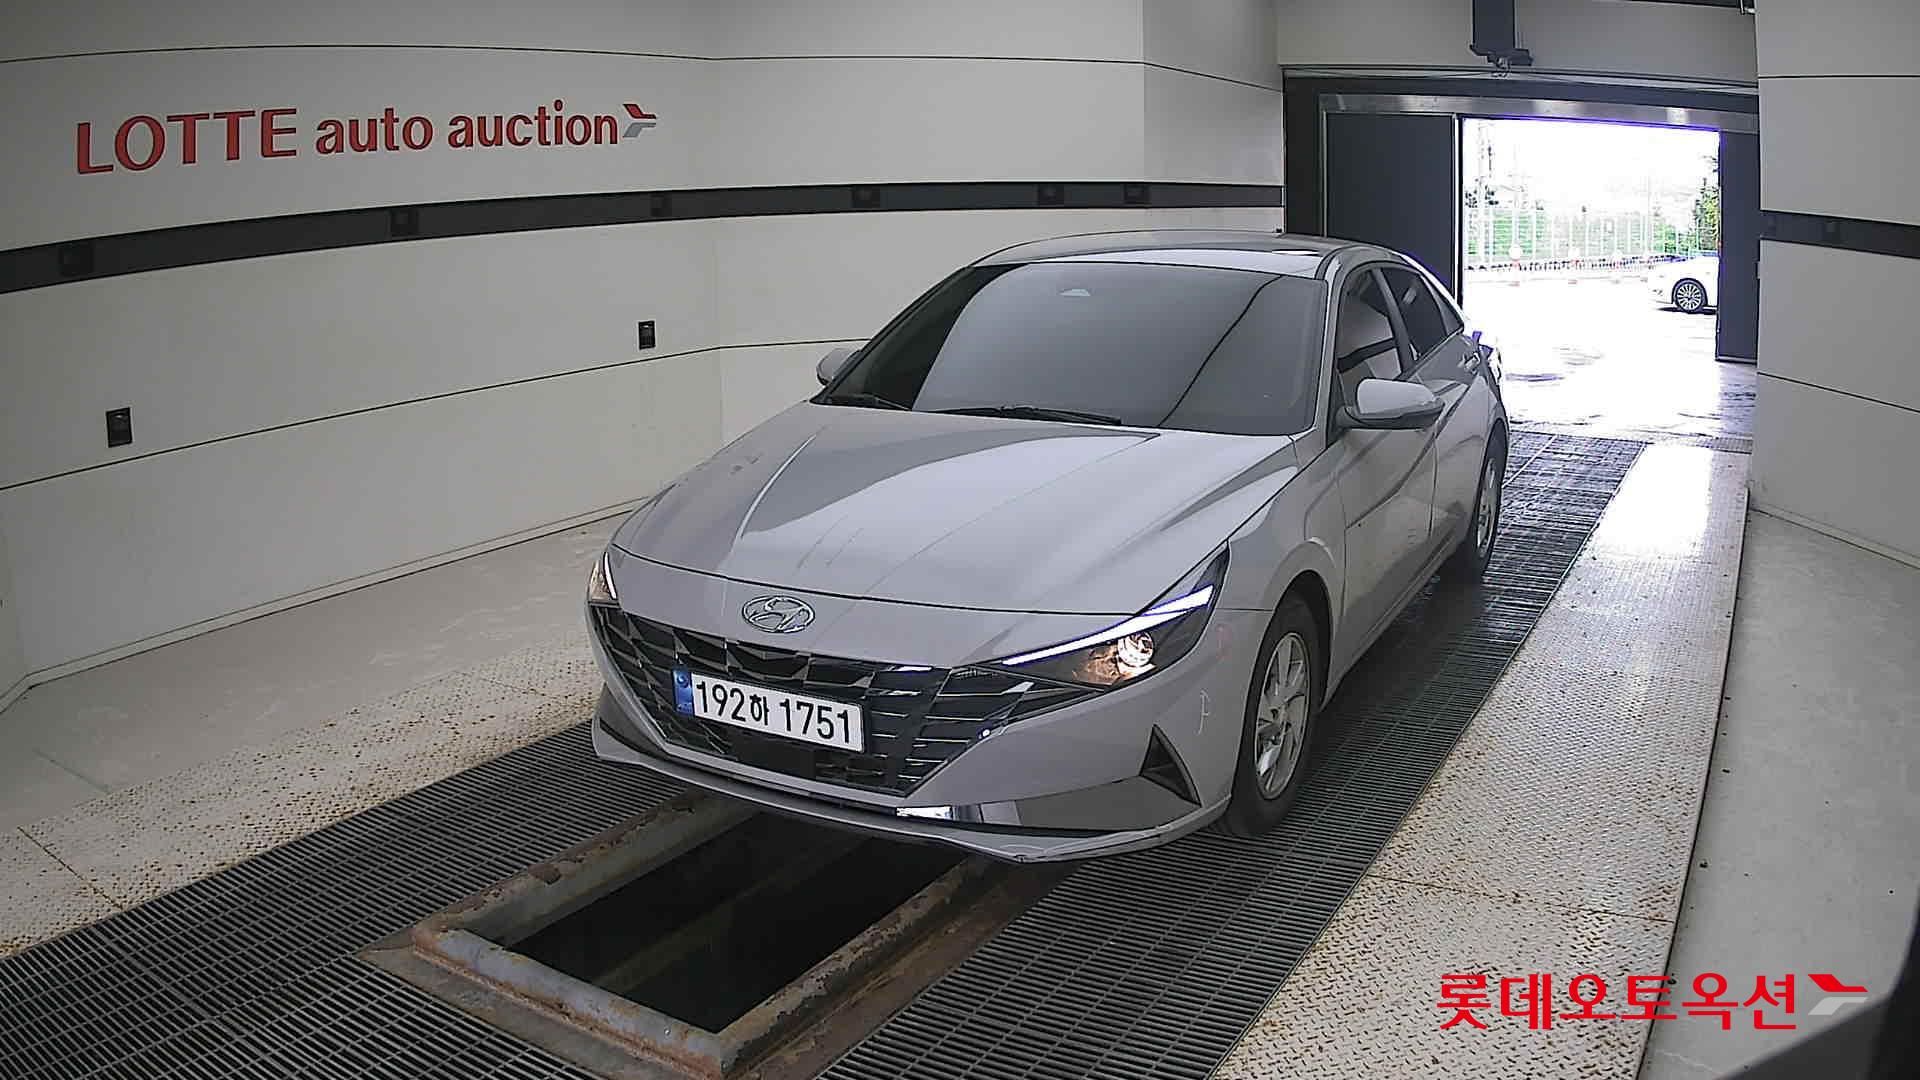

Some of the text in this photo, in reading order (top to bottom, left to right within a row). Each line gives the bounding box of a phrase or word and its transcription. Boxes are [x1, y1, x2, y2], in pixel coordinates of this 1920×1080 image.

[76, 99, 619, 175] LOTTE auto auction
[696, 680, 850, 744] 192하 1751
